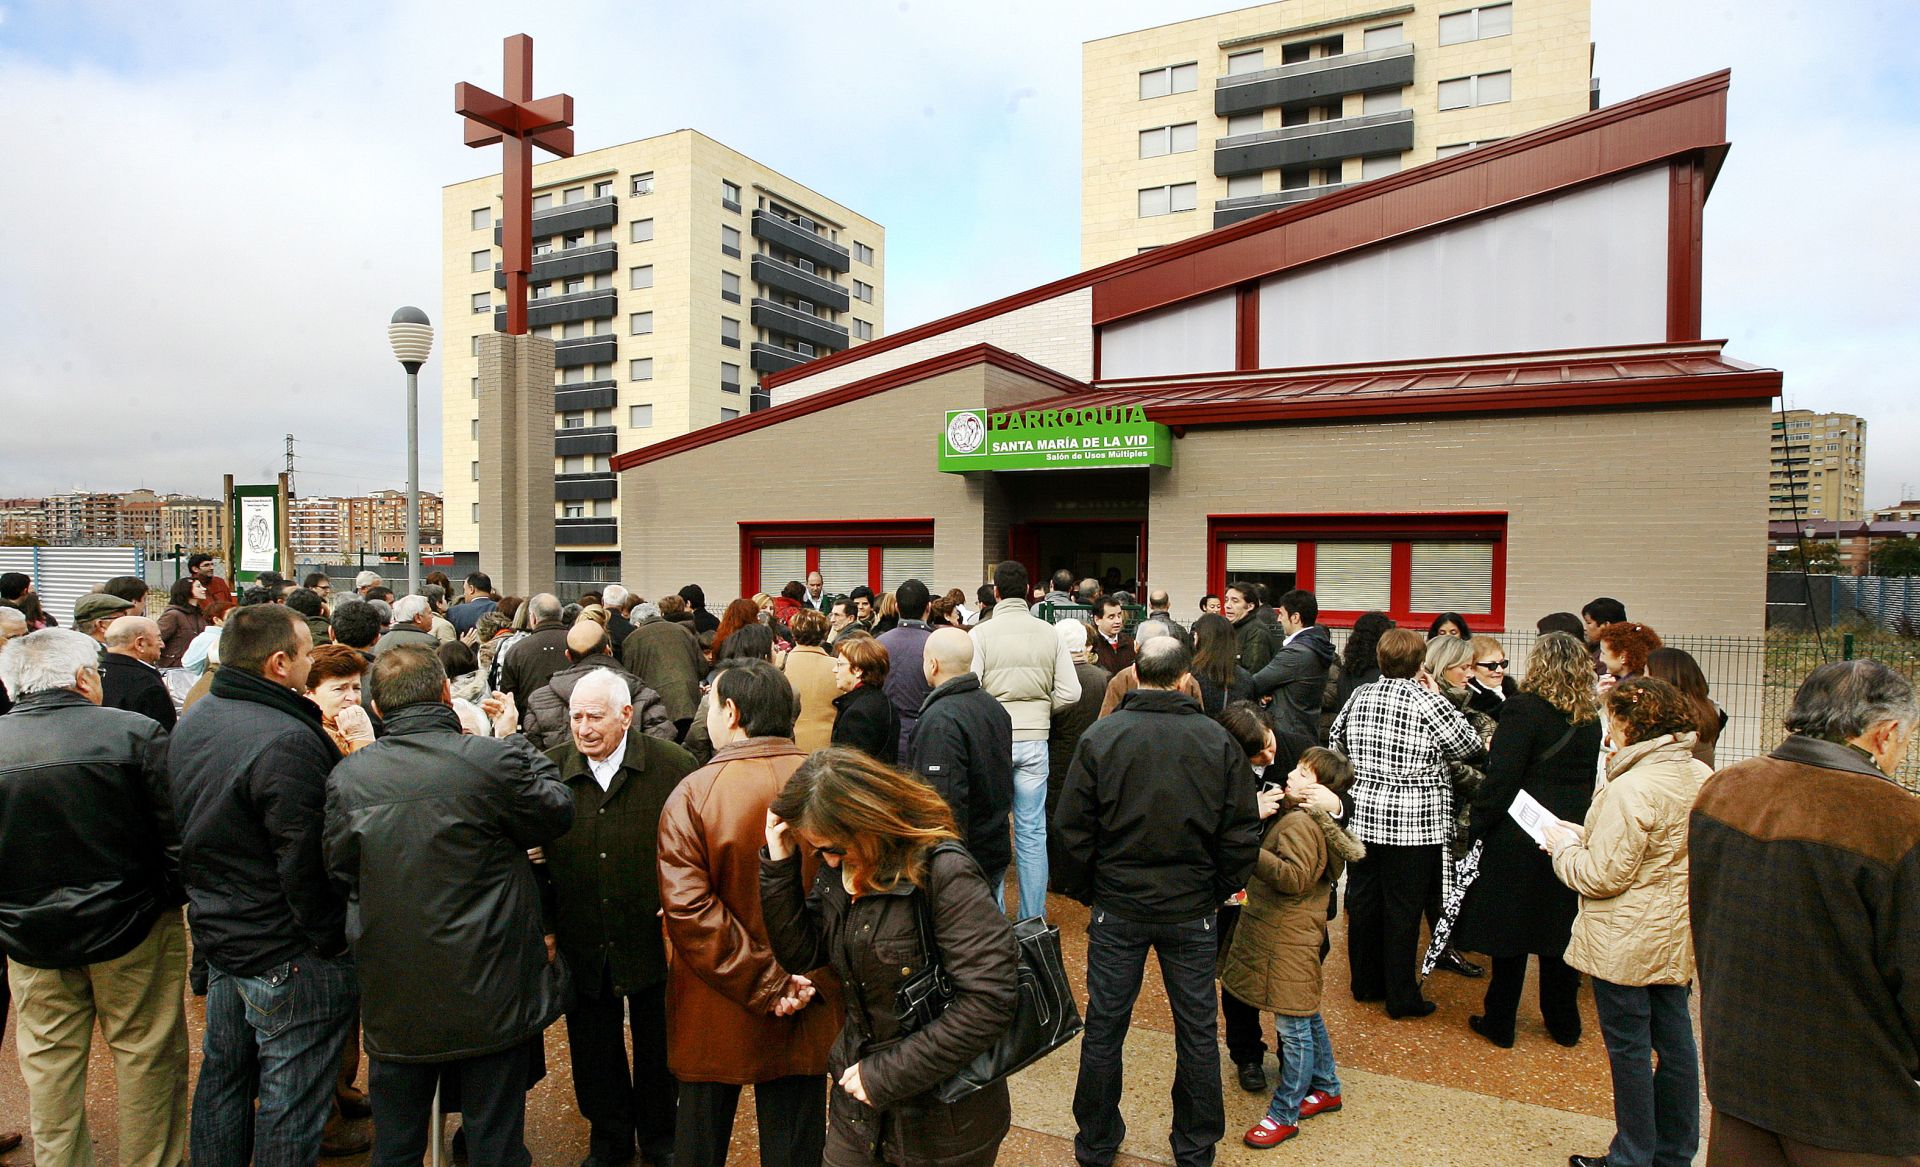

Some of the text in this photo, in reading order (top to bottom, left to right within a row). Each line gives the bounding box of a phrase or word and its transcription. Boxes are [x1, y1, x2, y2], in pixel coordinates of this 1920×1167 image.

[992, 404, 1148, 431] PARROQUIA
[992, 435, 1148, 452] SANTA MARÍA DE LA VID
[1046, 450, 1148, 461] Salón de Usos Múltiples
